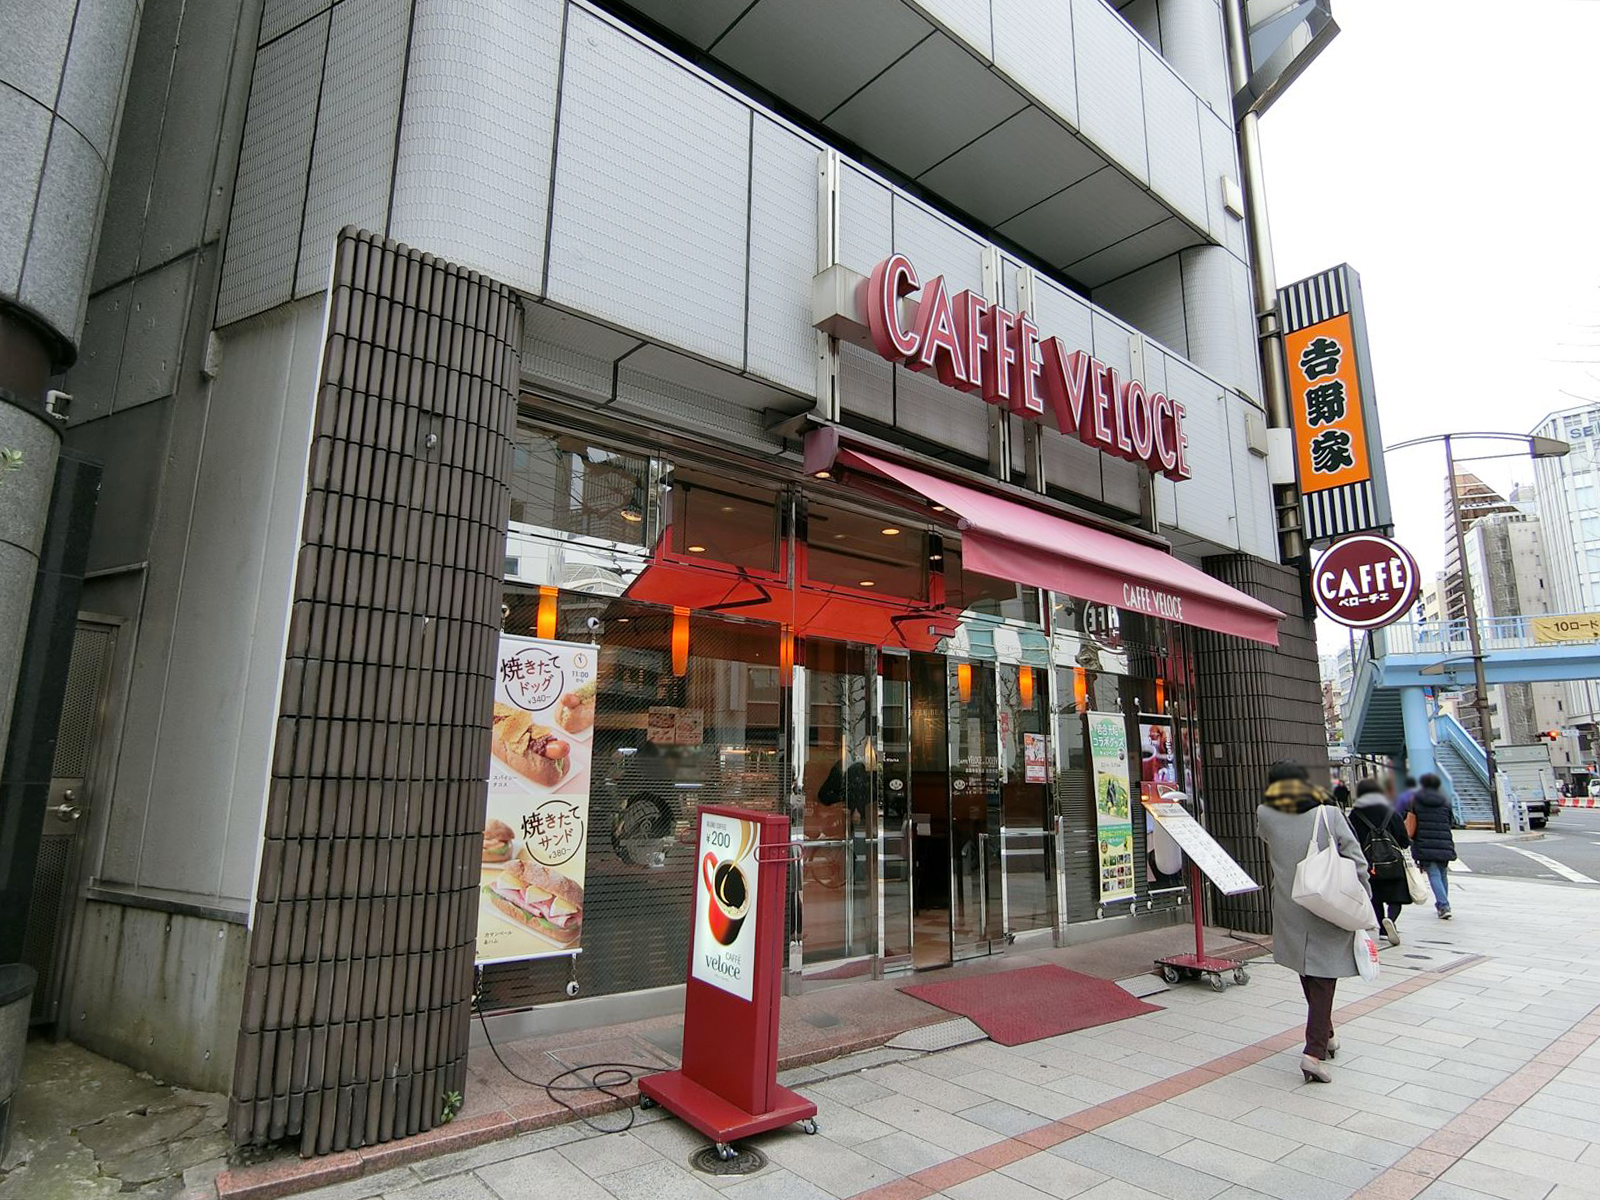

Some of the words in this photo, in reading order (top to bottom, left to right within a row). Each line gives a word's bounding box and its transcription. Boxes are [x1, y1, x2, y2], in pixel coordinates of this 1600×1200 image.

[1040, 336, 1193, 482] VELOCE
[1299, 337, 1354, 475] 吉野家
[1151, 590, 1184, 620] VELOCE
[1338, 591, 1390, 608] ベローチェ
[500, 655, 561, 683] 焼きたて
[571, 670, 589, 678] 11:00
[519, 674, 555, 696] ドッグ
[1093, 736, 1125, 748] コラボグッズ
[521, 806, 582, 840] 焼きたて
[538, 828, 574, 851] サンド
[706, 830, 731, 849] ¥200
[705, 954, 742, 980] veloce
